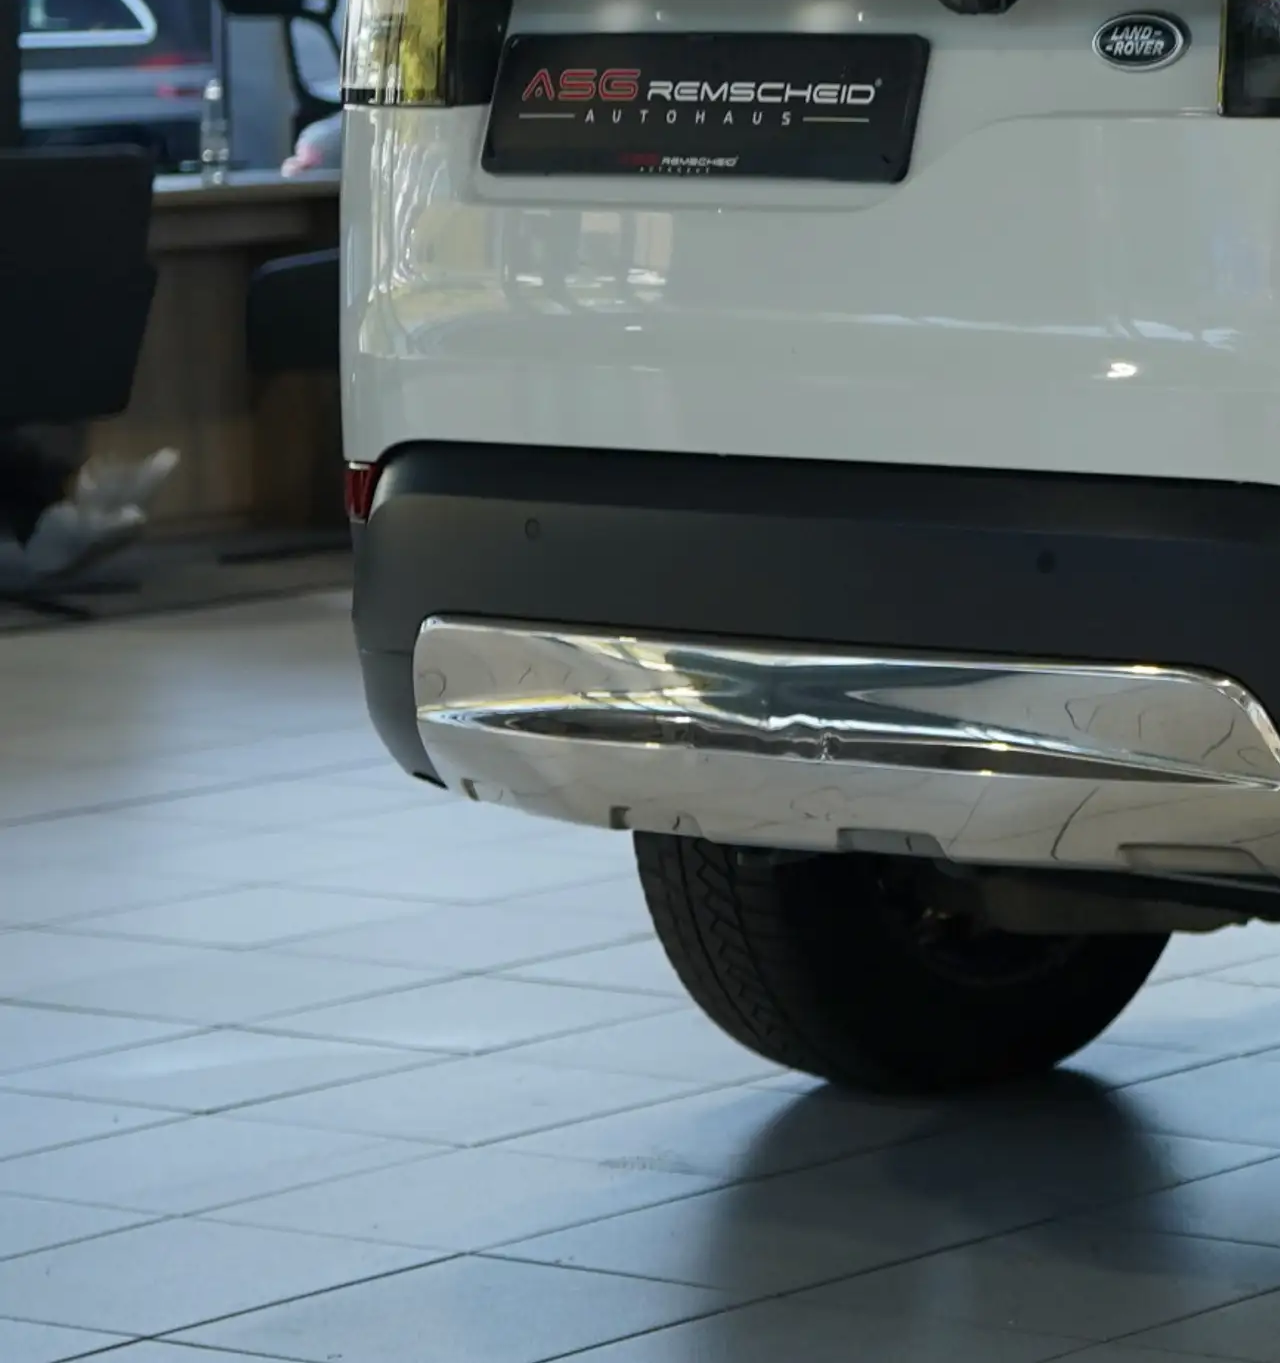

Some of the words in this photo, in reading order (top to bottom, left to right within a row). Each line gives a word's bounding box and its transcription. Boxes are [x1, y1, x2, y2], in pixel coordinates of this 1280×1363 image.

[521, 67, 642, 102] ASG
[646, 80, 877, 105] REMSCHEID
[584, 108, 792, 127] AUTOHAUS
